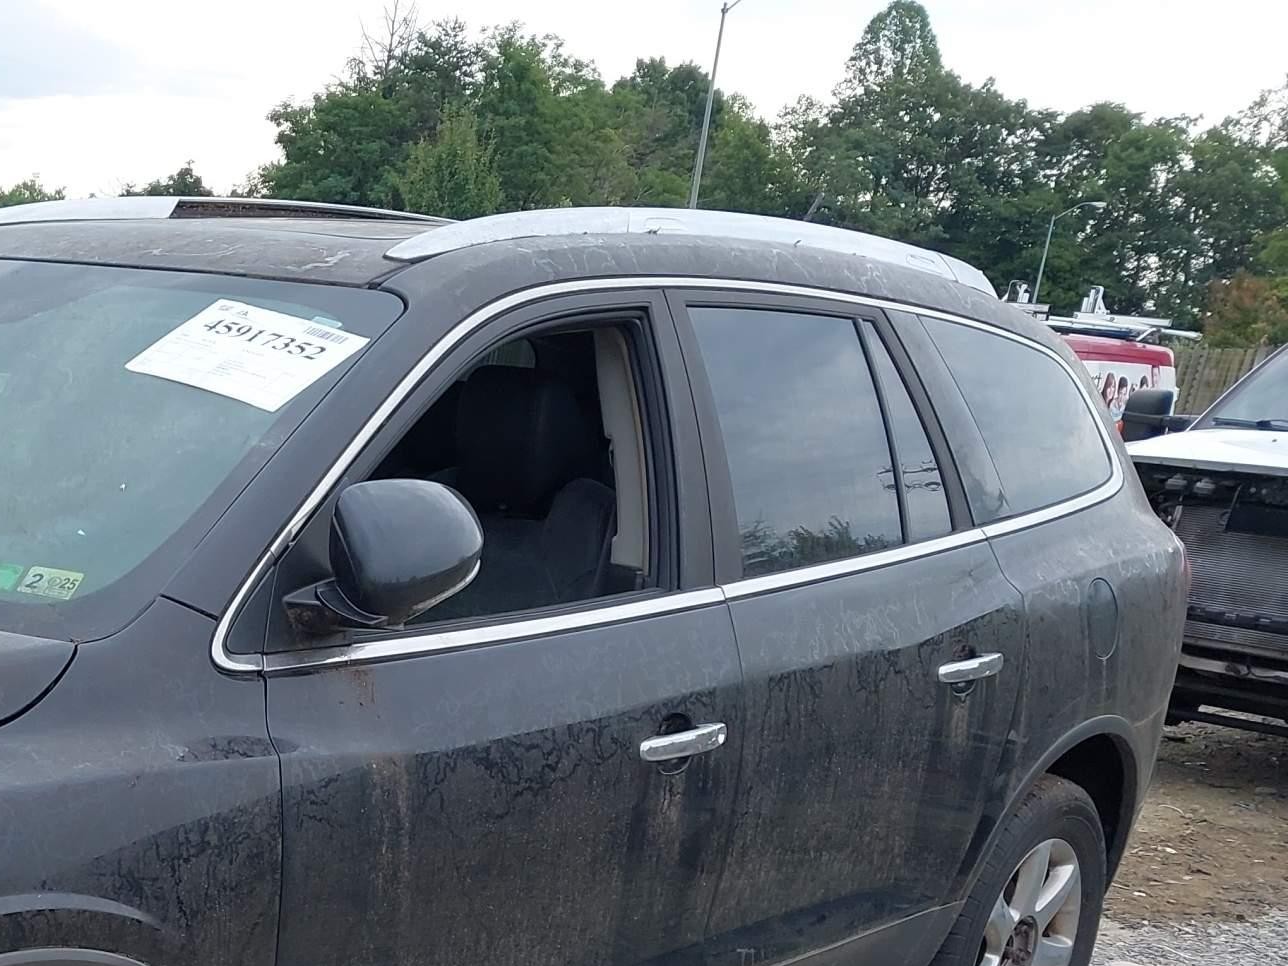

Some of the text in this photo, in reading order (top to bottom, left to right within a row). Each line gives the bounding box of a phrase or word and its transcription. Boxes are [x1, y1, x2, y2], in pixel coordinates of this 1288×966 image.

[203, 319, 327, 360] 45917352
[25, 573, 80, 590] 2 25
